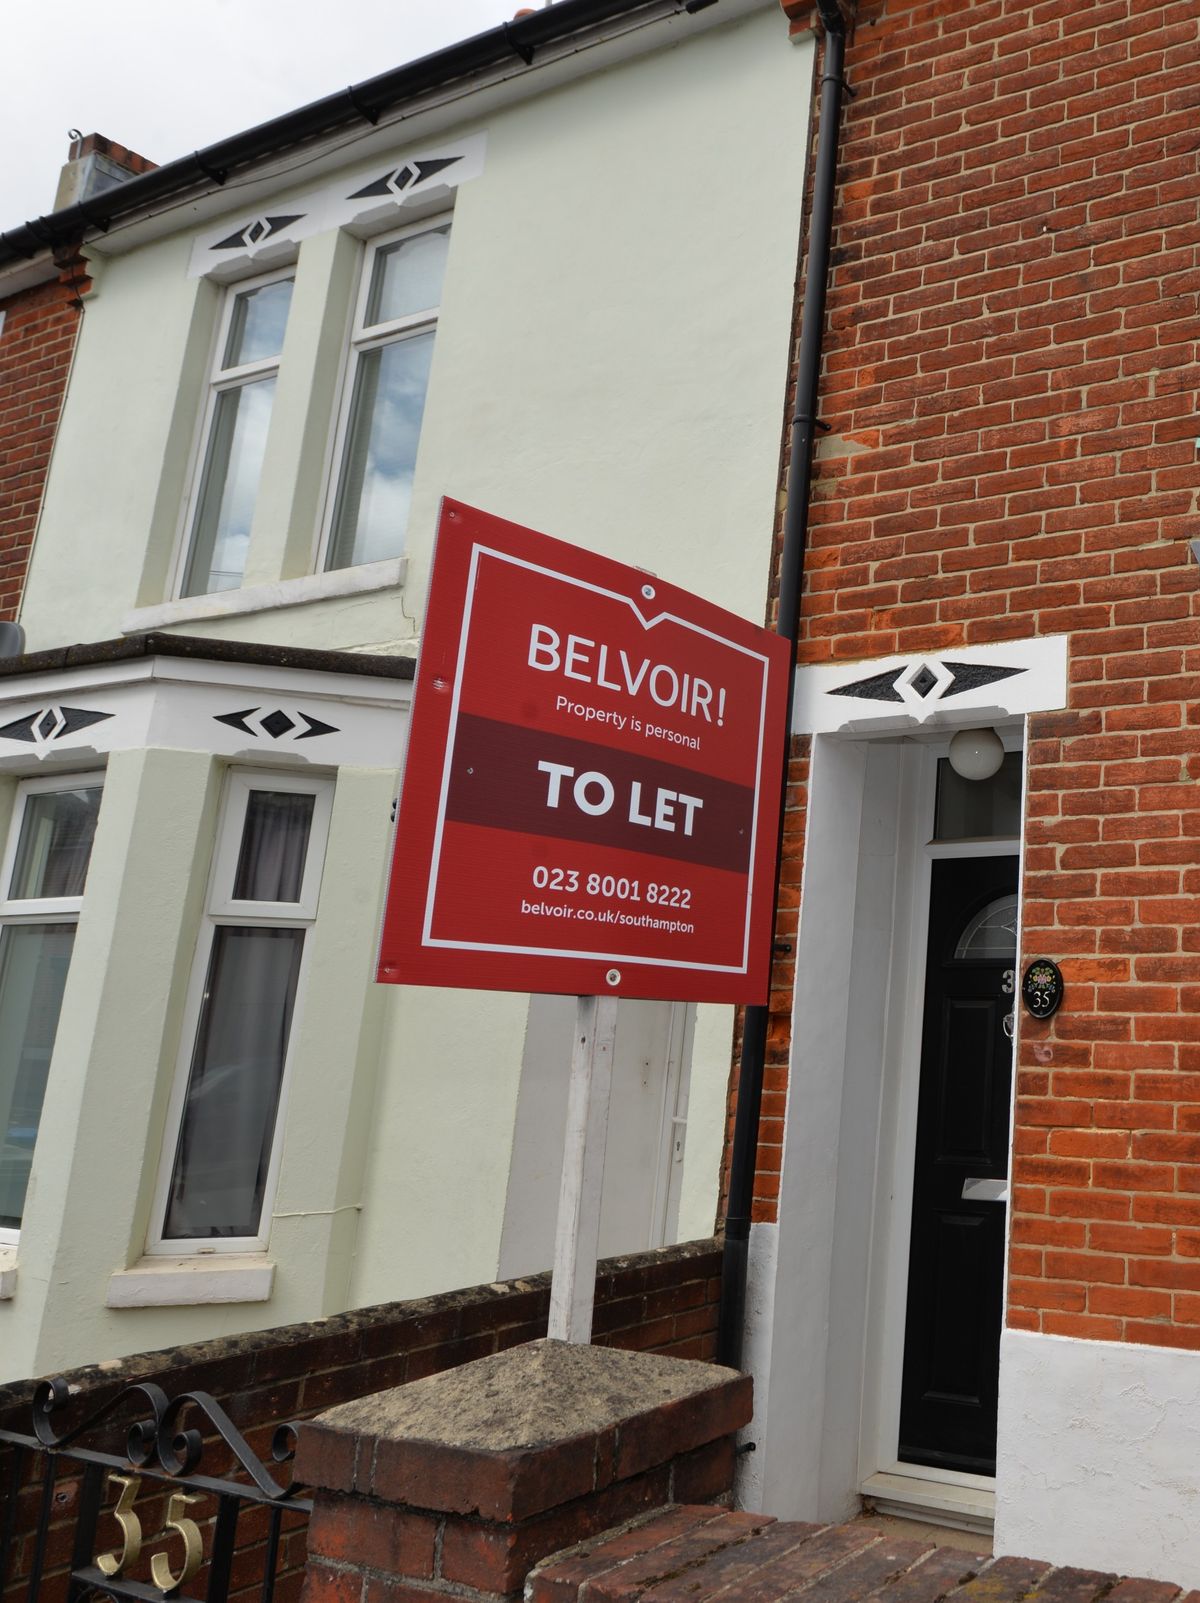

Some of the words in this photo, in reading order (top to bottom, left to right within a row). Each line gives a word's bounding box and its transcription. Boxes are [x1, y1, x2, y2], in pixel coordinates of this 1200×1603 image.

[528, 623, 726, 727] BELVOIR!
[556, 695, 627, 730] Property
[631, 716, 642, 731] is
[645, 724, 701, 750] personal
[538, 760, 615, 816] TO
[629, 781, 704, 836] LET
[532, 866, 580, 893] 023
[586, 874, 641, 901] 8001
[647, 883, 692, 909] 8222
[521, 900, 694, 934] belvoir.co.uk/southampton
[1032, 991, 1051, 1008] 35
[97, 1474, 206, 1593] 35
